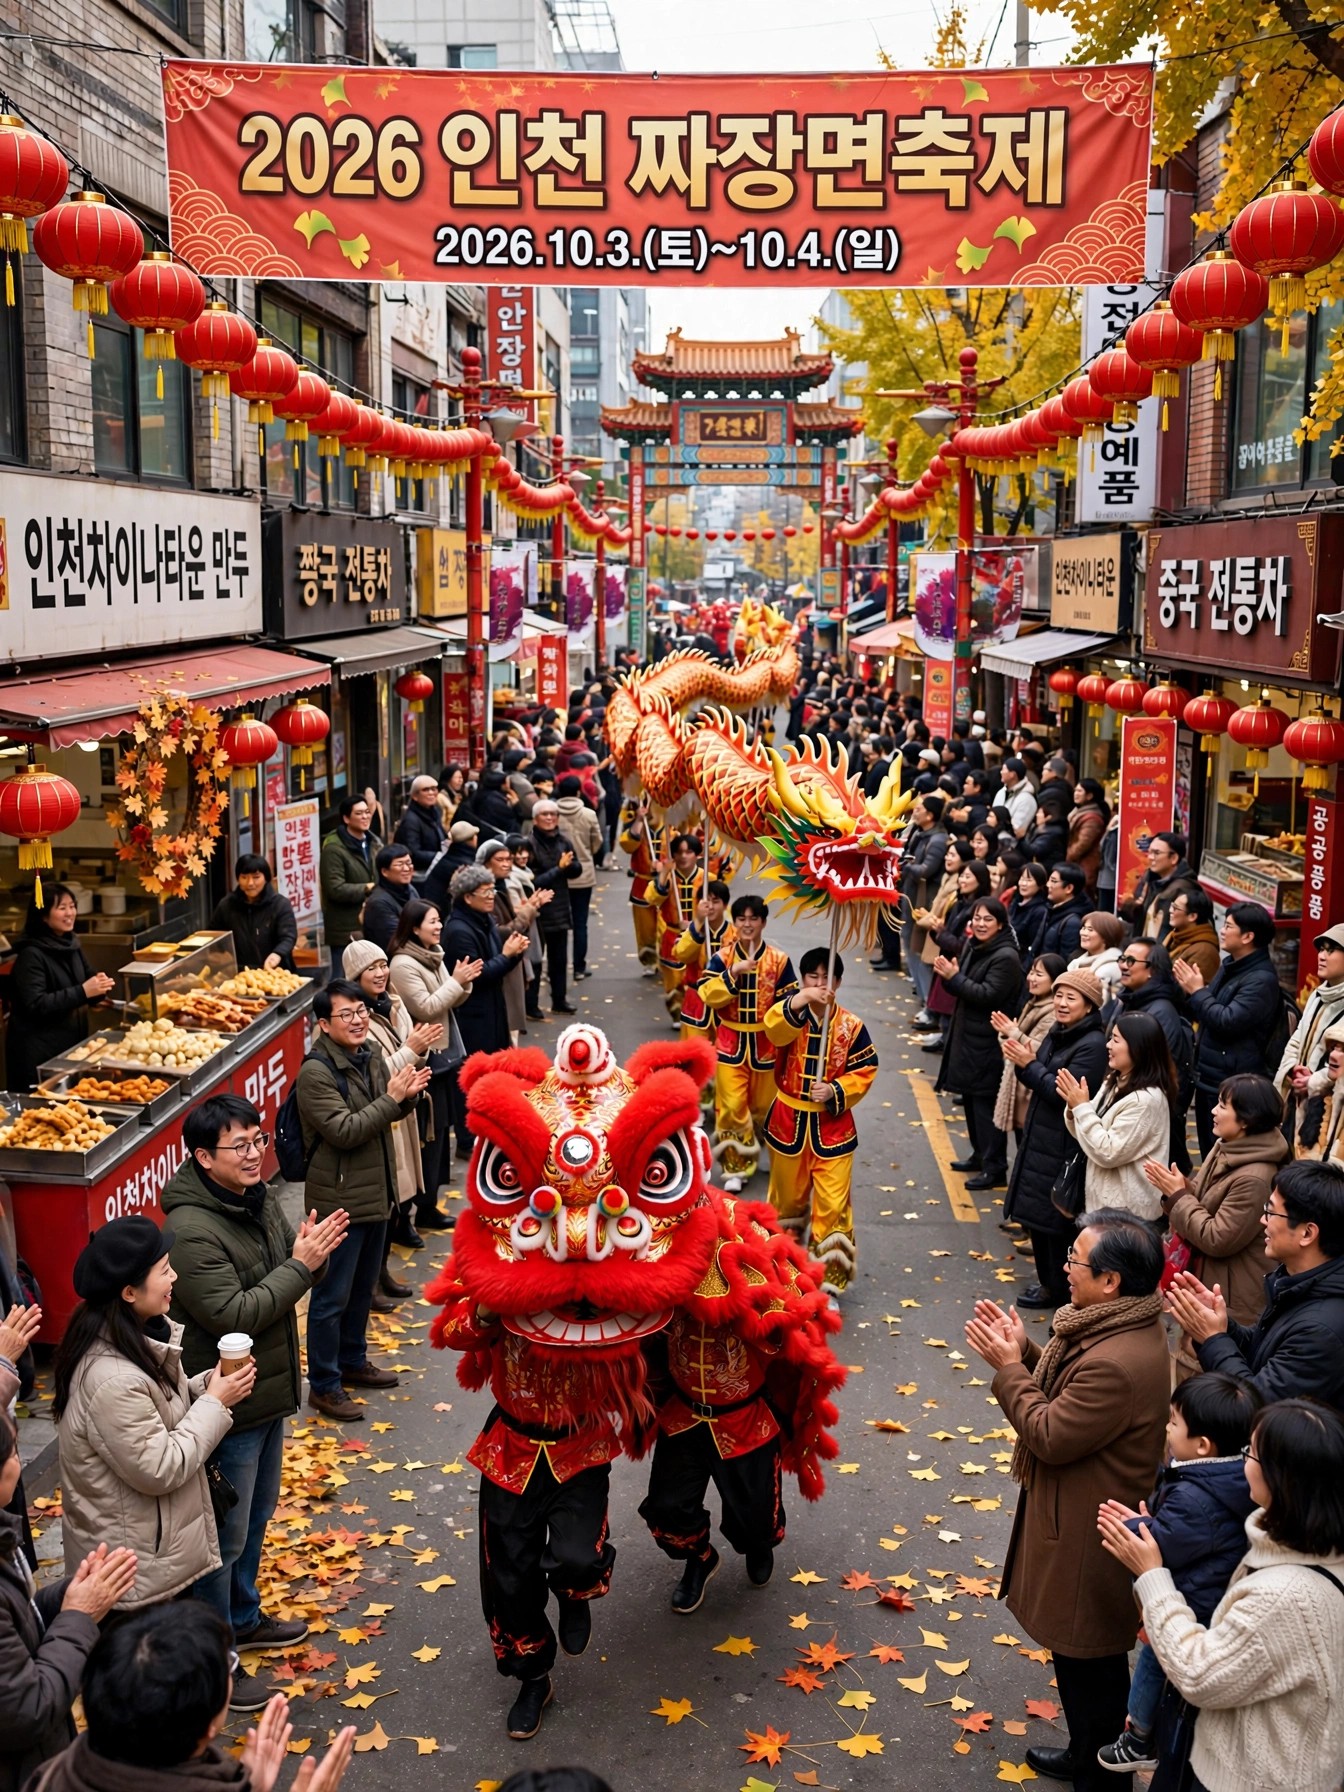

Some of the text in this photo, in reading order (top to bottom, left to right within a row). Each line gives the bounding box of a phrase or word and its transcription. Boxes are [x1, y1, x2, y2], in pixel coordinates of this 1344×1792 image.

[239, 107, 1068, 211] 2026 인천 짜장면축제
[434, 226, 901, 273] 2026.10.3.(토)~10.4.(일)
[24, 516, 249, 609] 인천차이나타운 만두
[344, 544, 392, 603] 전통차
[1158, 555, 1290, 636] 중국 전통차
[244, 1049, 288, 1124] 만두
